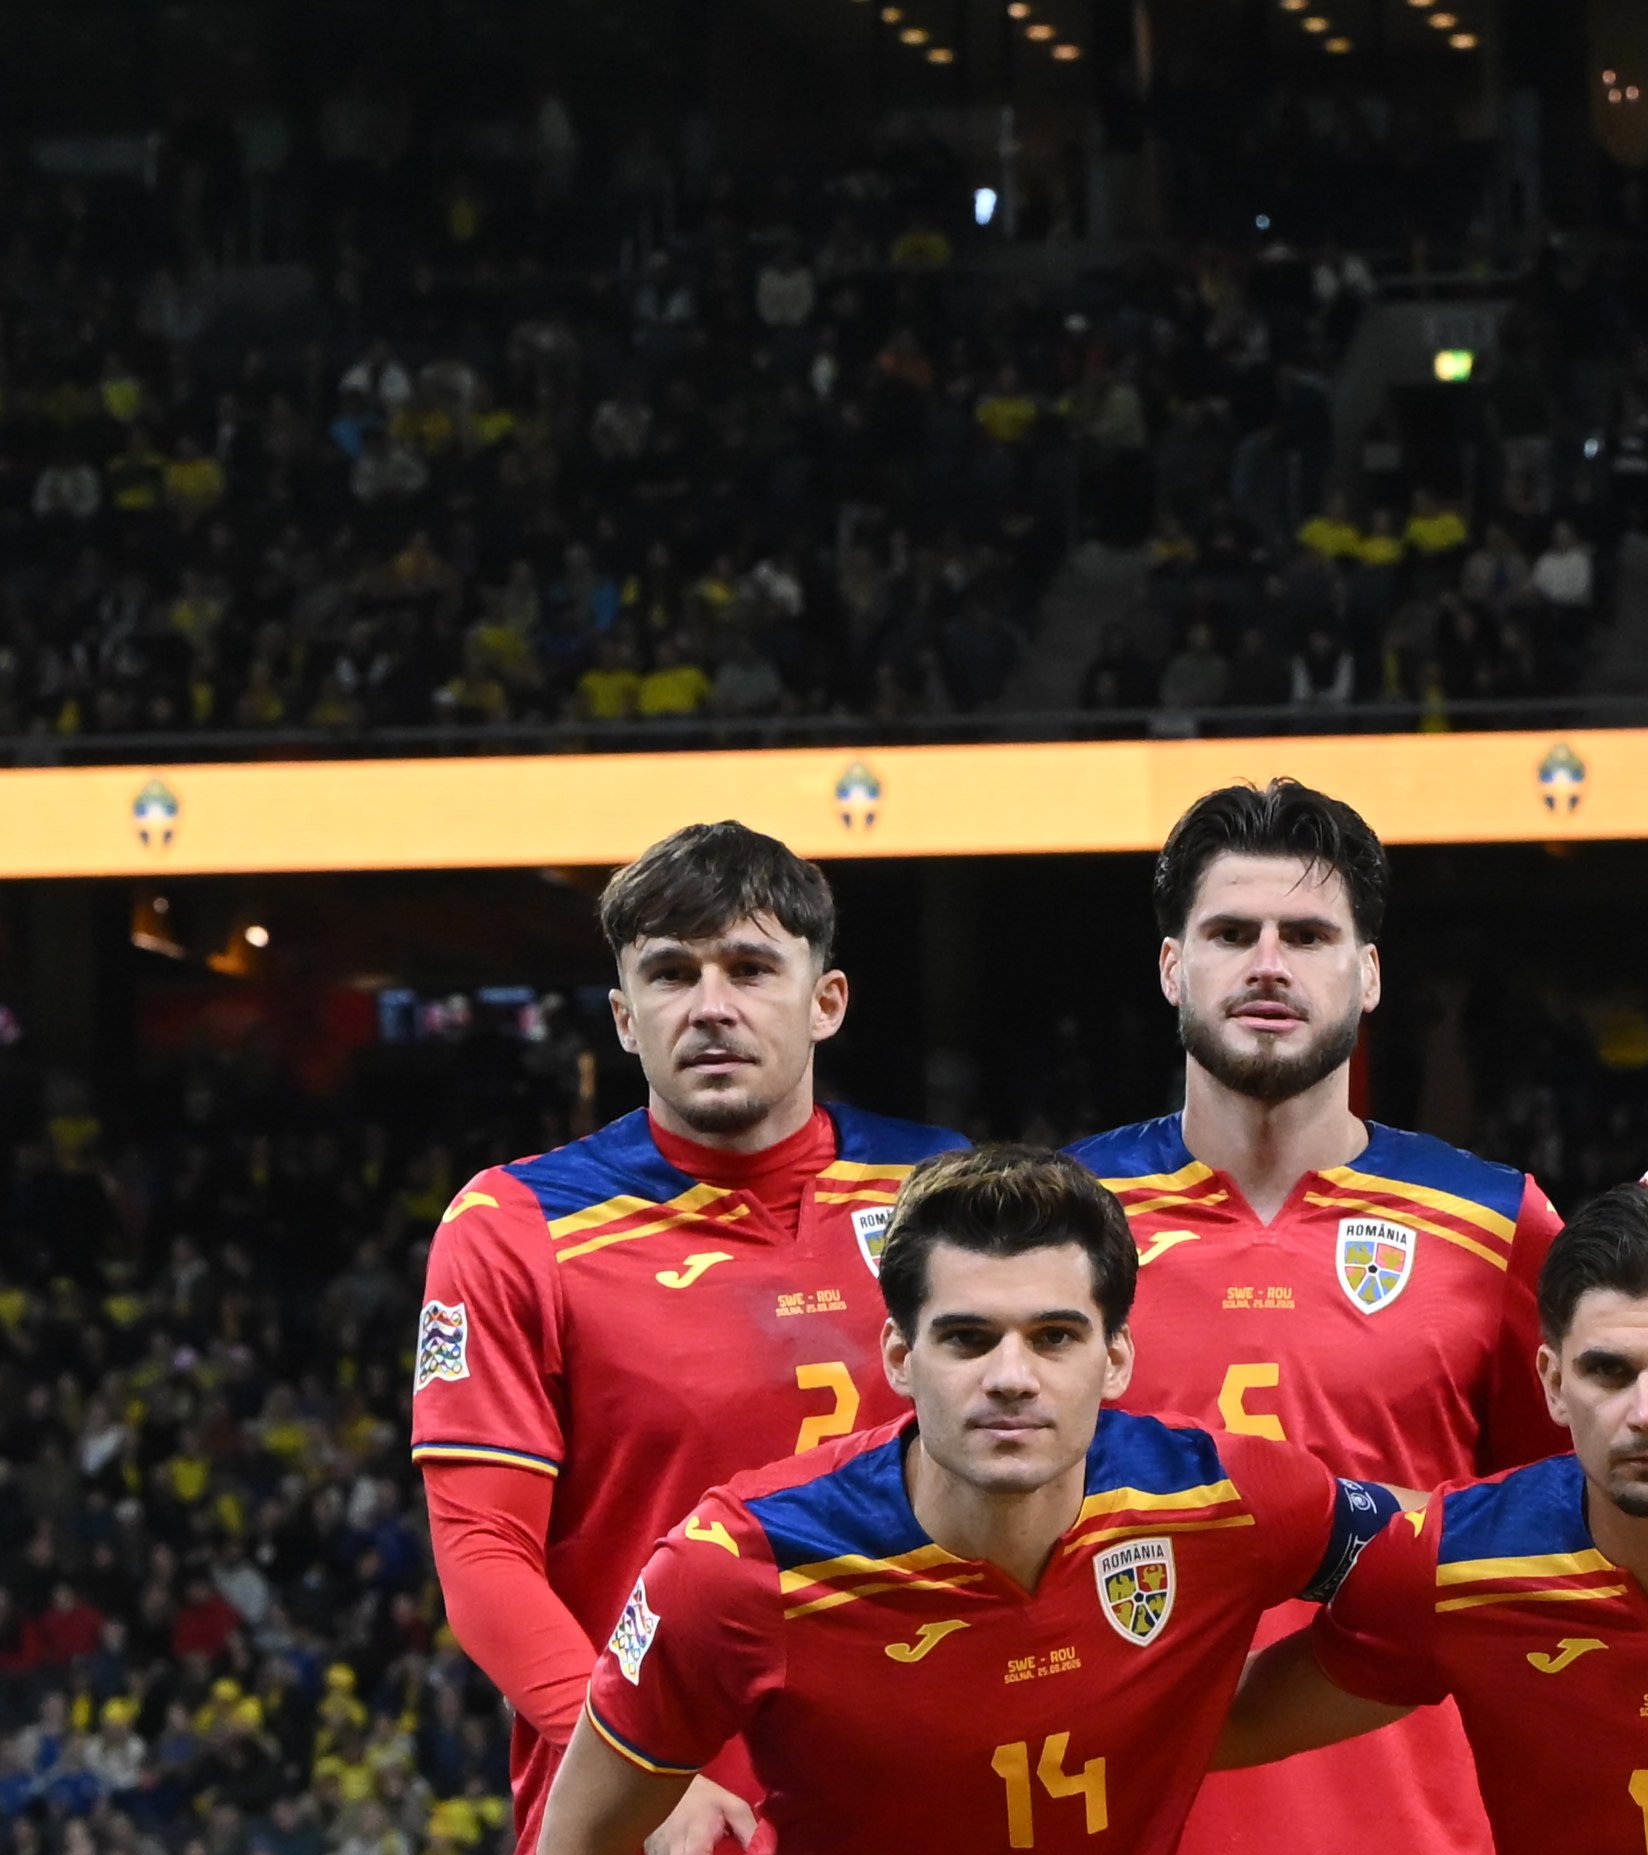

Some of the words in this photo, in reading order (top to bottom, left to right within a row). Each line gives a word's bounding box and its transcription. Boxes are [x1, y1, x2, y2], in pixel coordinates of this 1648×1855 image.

[1346, 1224, 1407, 1245] ROMÂNIA
[778, 1293, 804, 1307] SWE
[817, 1289, 840, 1302] ROU
[1227, 1287, 1254, 1299] SWE
[1267, 1287, 1292, 1299] ROU
[795, 1361, 860, 1457] 2
[1102, 1543, 1164, 1573] ROMÂNIA
[1008, 1656, 1035, 1672] SWE
[1050, 1646, 1075, 1663] ROU
[991, 1731, 1108, 1848] 14
